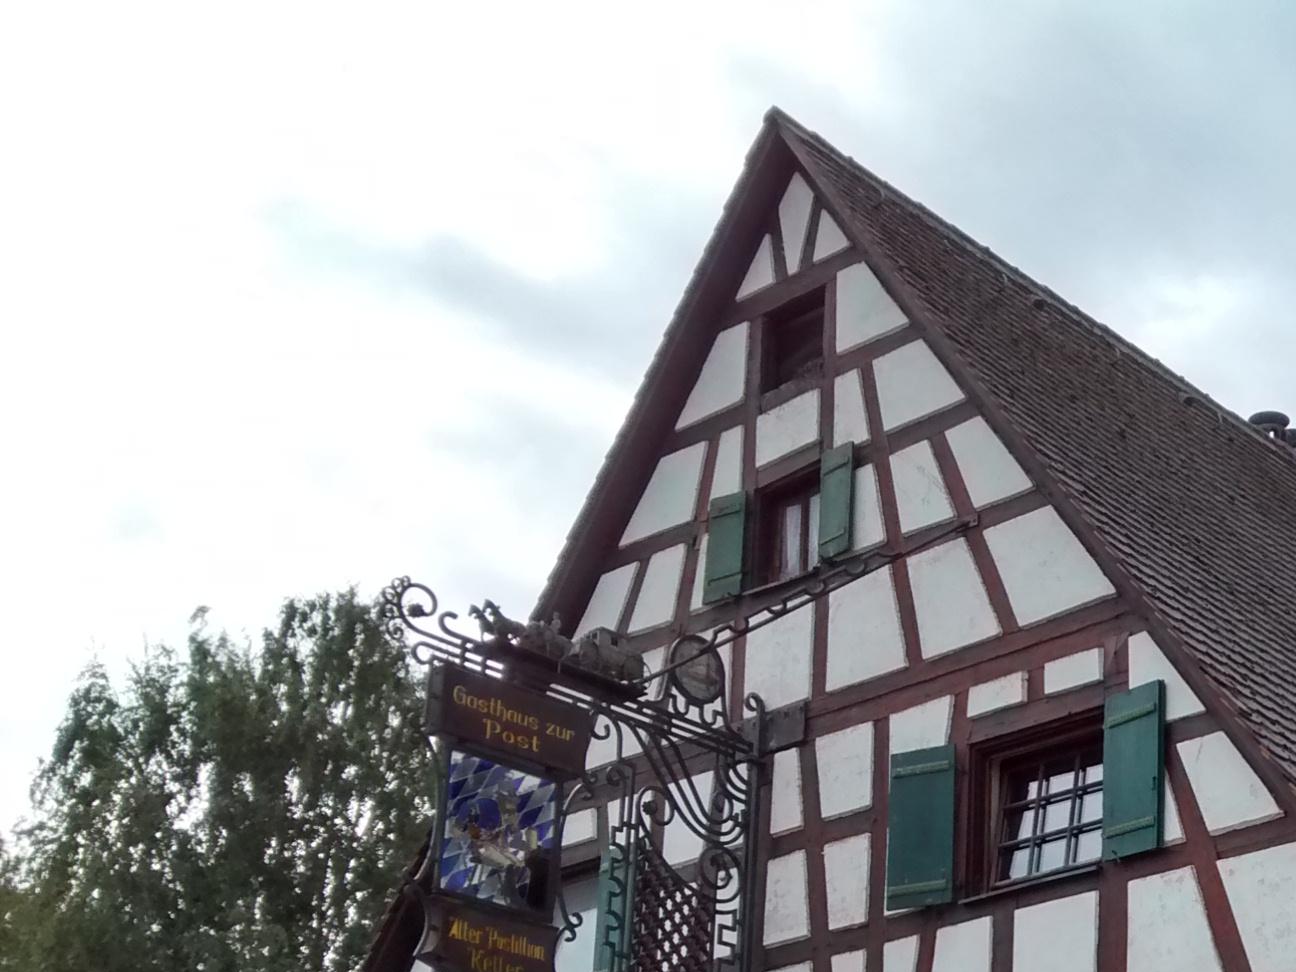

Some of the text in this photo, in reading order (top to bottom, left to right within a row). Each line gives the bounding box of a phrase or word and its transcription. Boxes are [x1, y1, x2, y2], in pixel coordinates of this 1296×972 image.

[453, 685, 575, 741] Gasthaus zur
[483, 718, 539, 753] Post
[448, 916, 483, 944] Alter
